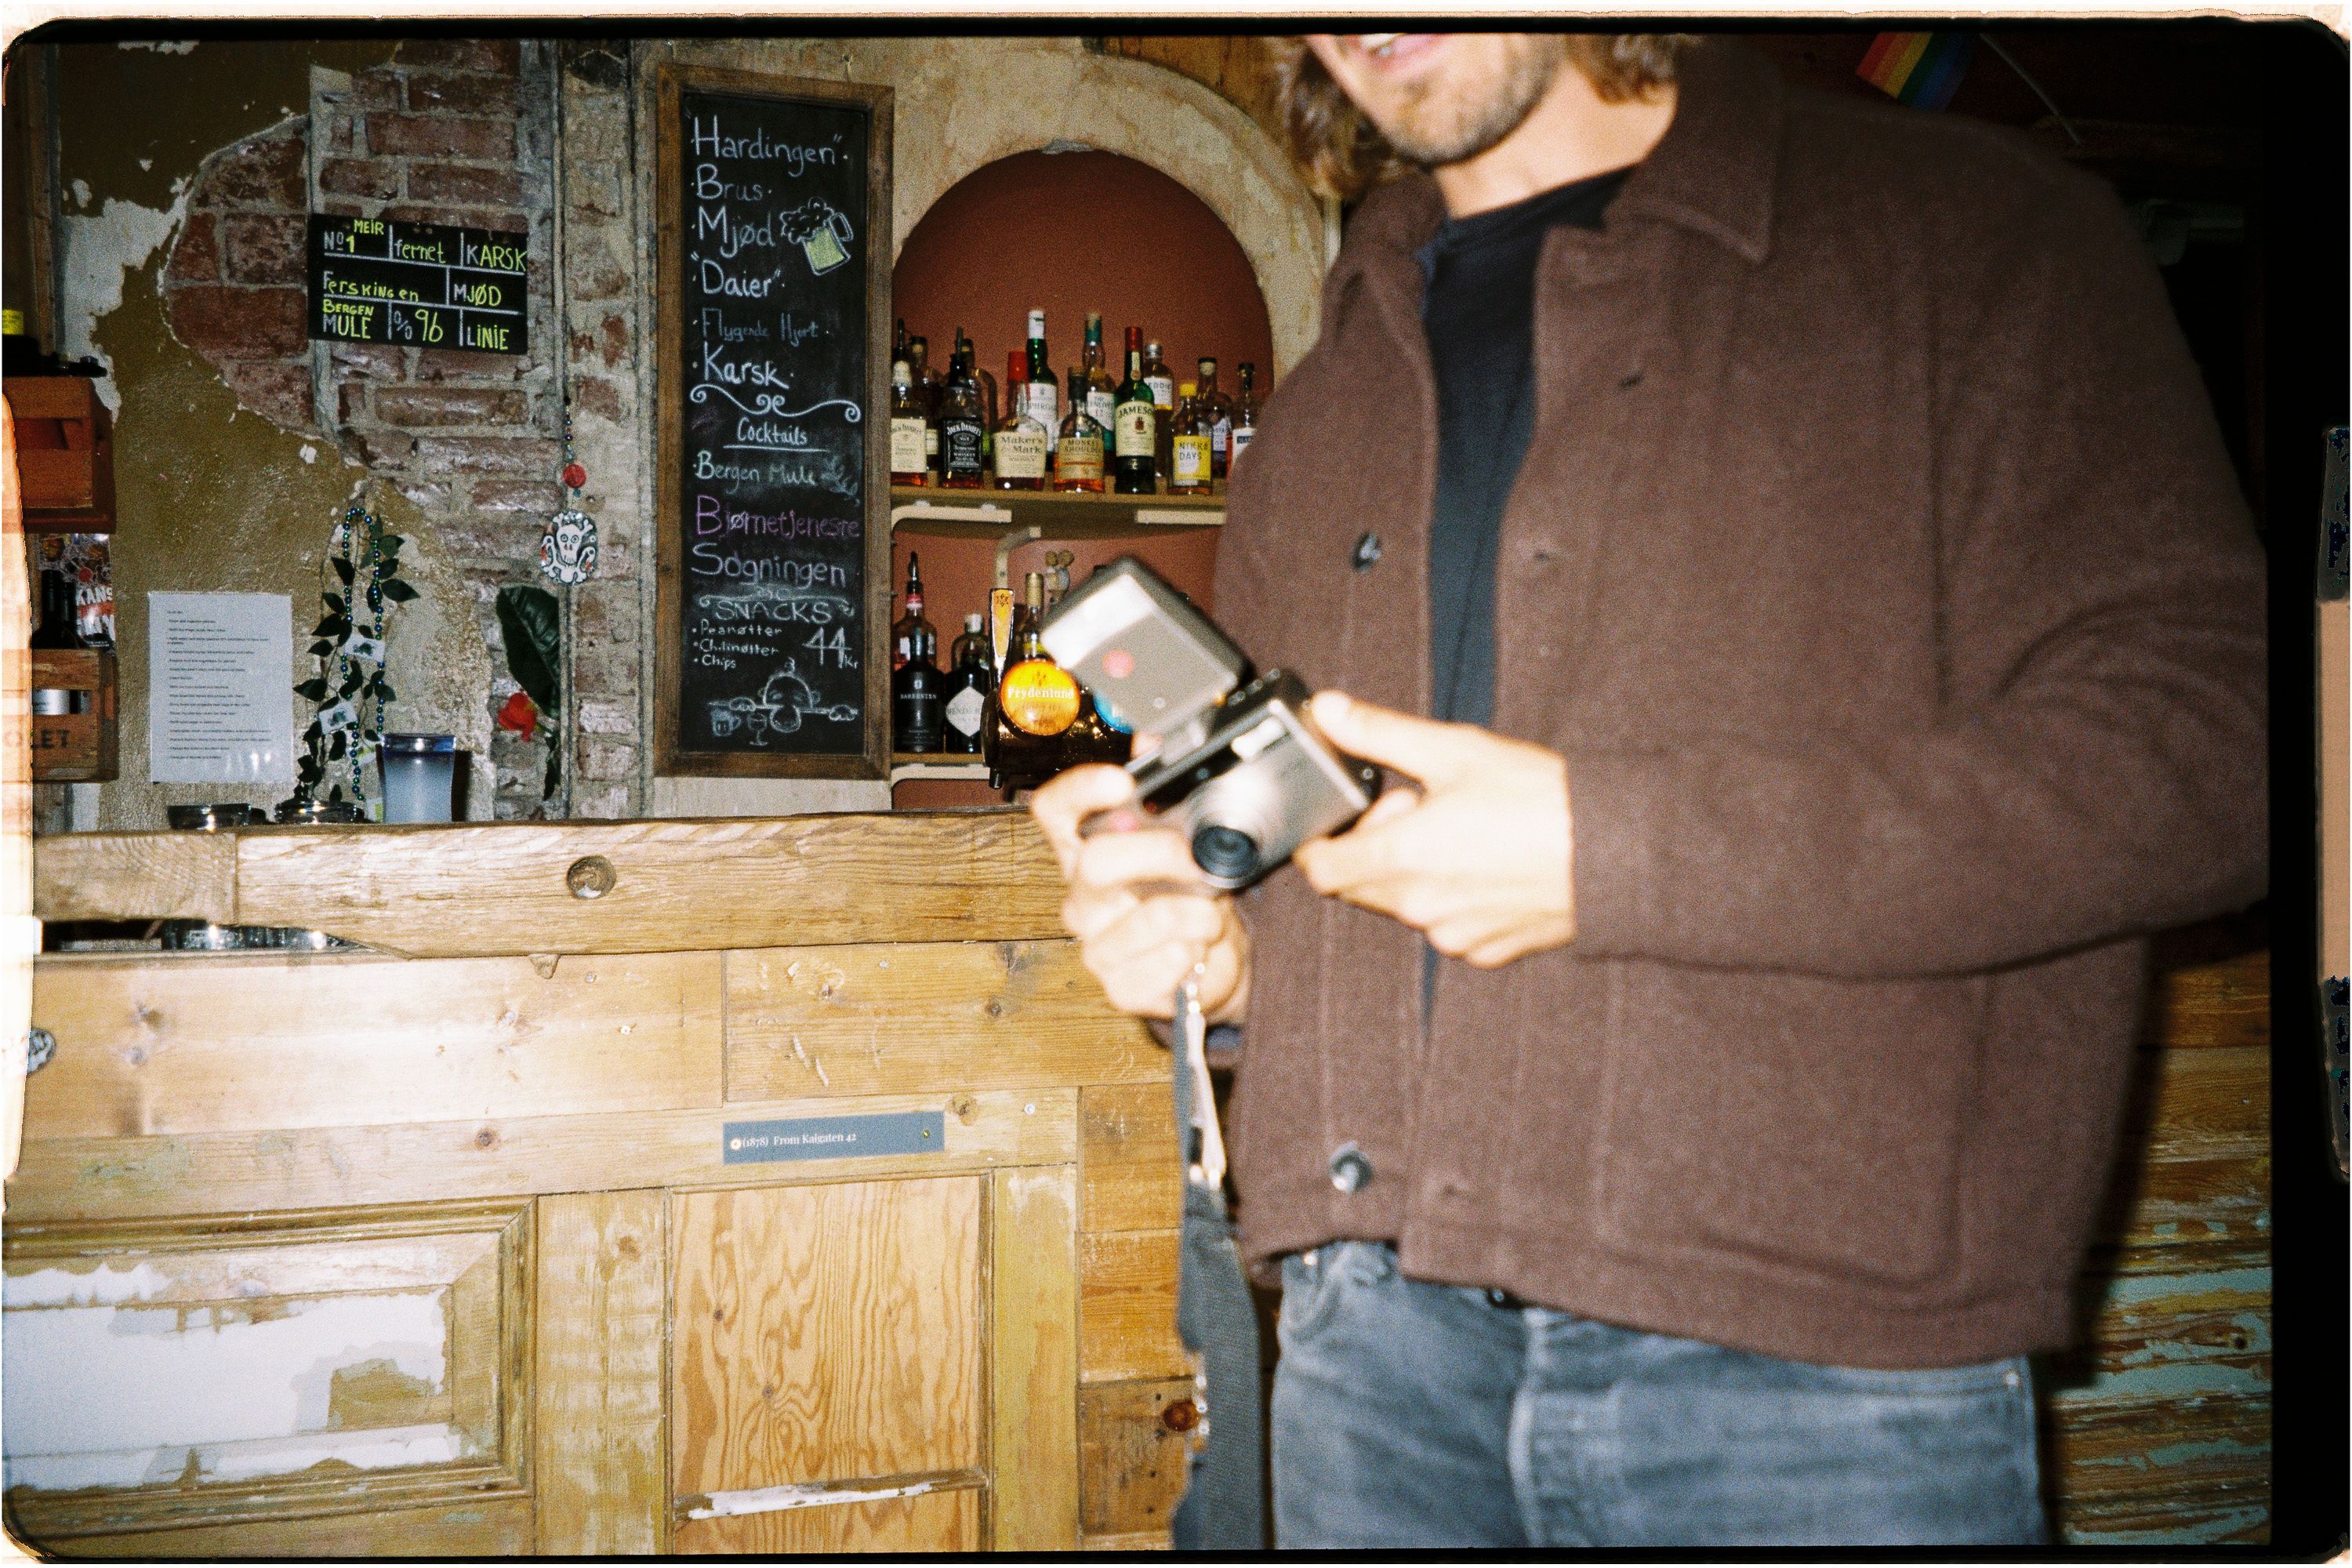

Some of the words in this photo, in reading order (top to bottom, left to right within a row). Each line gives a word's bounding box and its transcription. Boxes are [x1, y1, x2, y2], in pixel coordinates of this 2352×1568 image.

[696, 163, 763, 201] Brus
[699, 205, 776, 259] Mjød
[453, 283, 502, 307] MJØD
[323, 314, 372, 339] MULE
[704, 340, 789, 390] Karsk
[737, 417, 808, 445] Cocktails
[697, 450, 759, 495] Bergen
[715, 601, 832, 624] SNACKS
[802, 626, 852, 668] 44
[702, 654, 737, 671] Chips
[774, 1135, 800, 1145] From
